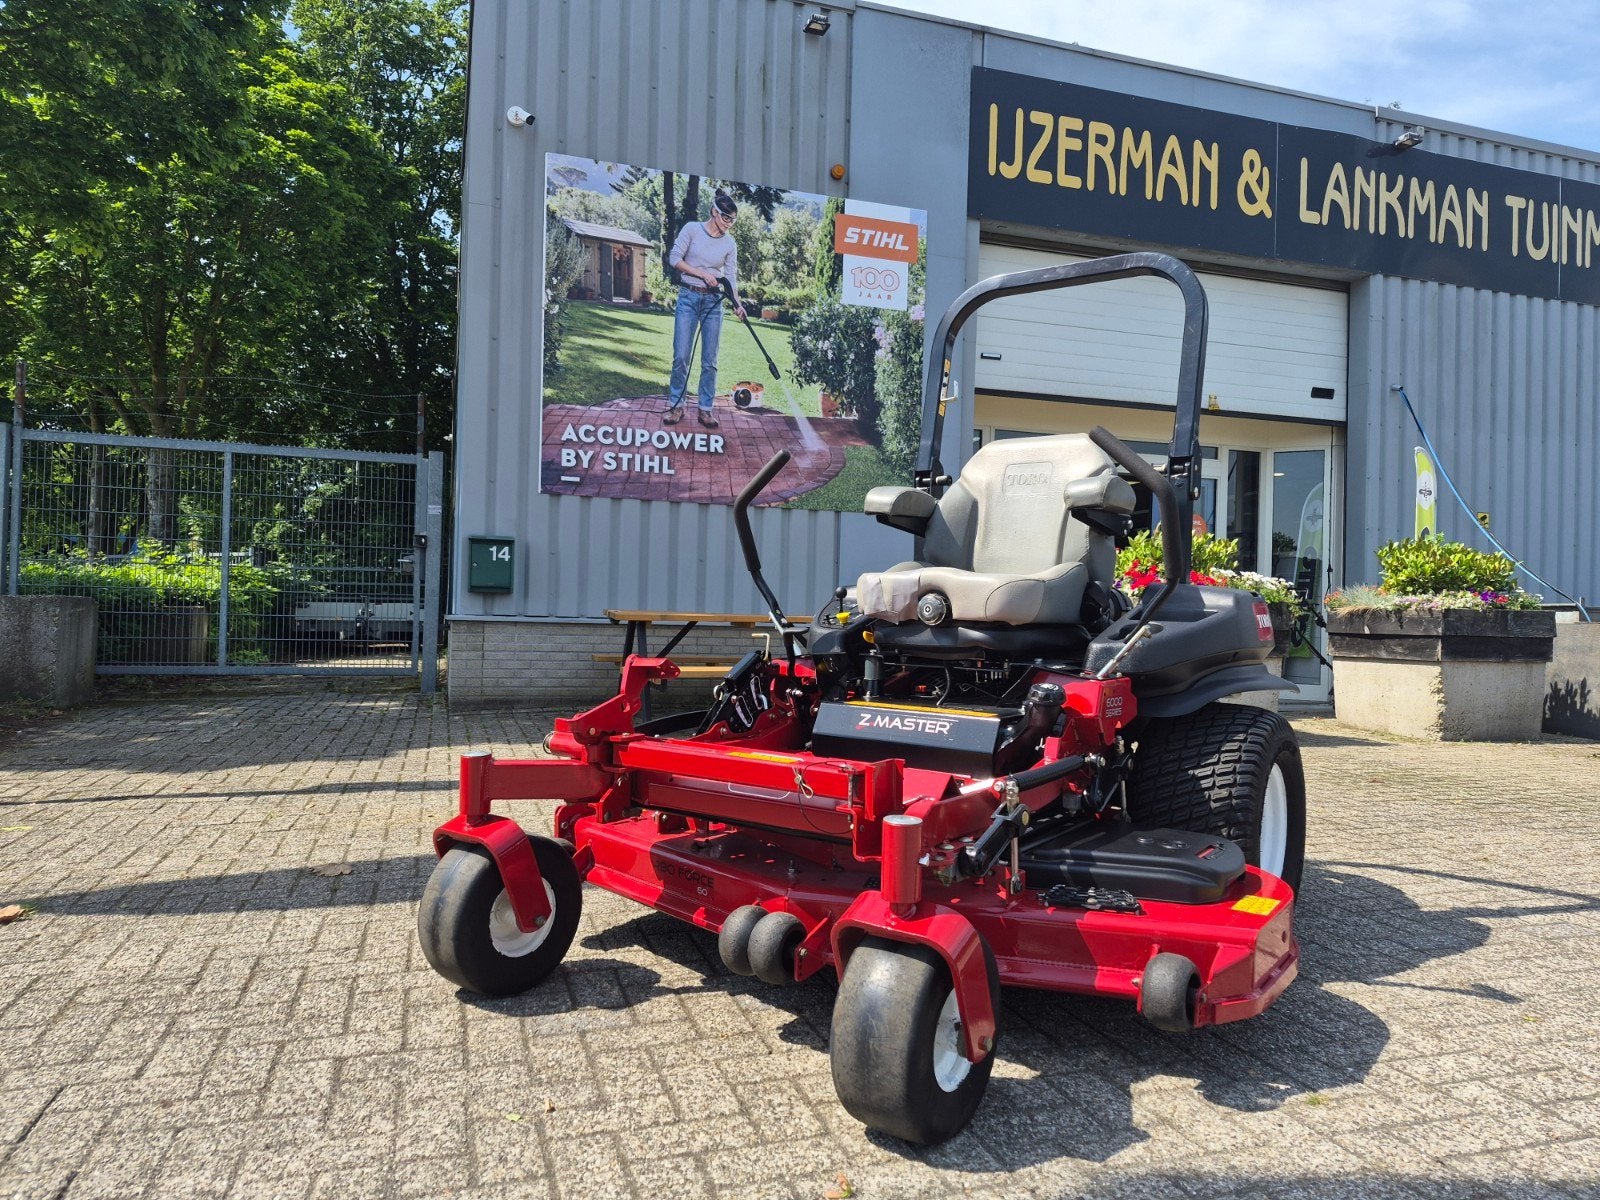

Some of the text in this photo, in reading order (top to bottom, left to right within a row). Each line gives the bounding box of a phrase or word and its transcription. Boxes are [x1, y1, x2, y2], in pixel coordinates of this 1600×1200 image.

[989, 103, 1219, 210] IJZERMAN
[1237, 149, 1273, 219] &
[1300, 157, 1489, 252] LANKMAN
[844, 227, 909, 251] STIHL
[851, 266, 900, 292] 100
[859, 292, 892, 300] JAAR
[561, 423, 724, 454] ACCUPOWER
[561, 448, 675, 475] BY STIHL
[489, 546, 511, 562] 14
[856, 713, 950, 735] Z MASTER
[678, 866, 714, 888] FORCE
